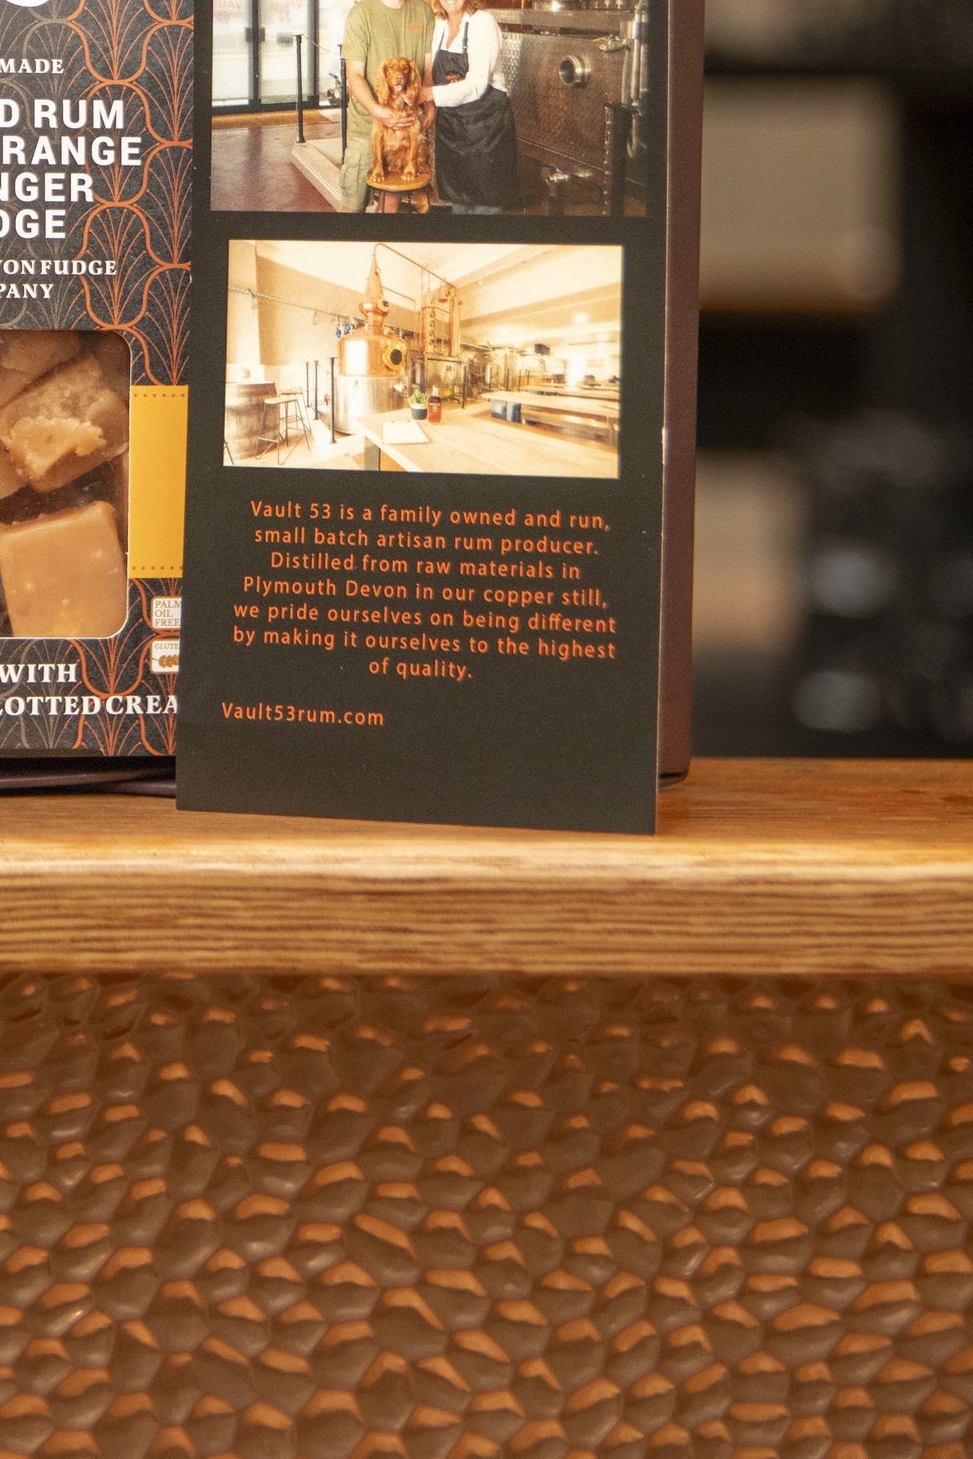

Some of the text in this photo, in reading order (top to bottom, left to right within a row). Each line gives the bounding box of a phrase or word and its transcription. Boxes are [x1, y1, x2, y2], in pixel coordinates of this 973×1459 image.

[33, 98, 124, 130] RUM
[39, 259, 117, 276] FUDGE
[250, 500, 611, 532] Vault 53 is a family owned and run,
[254, 527, 599, 556] small batch artisan rum producer.
[270, 552, 581, 581] Distilled from raw materials in
[243, 575, 608, 610] Plymouth Devon in our copper still,
[154, 609, 173, 618] OIL
[154, 618, 180, 628] FREE
[233, 603, 617, 634] we pride ourselves on being different
[154, 642, 179, 650] GLUTE
[233, 625, 616, 662] by making it ourselves to the highest
[368, 656, 473, 682] of quality.
[105, 695, 178, 715] CREA
[221, 701, 385, 726] Vault53rum.com
